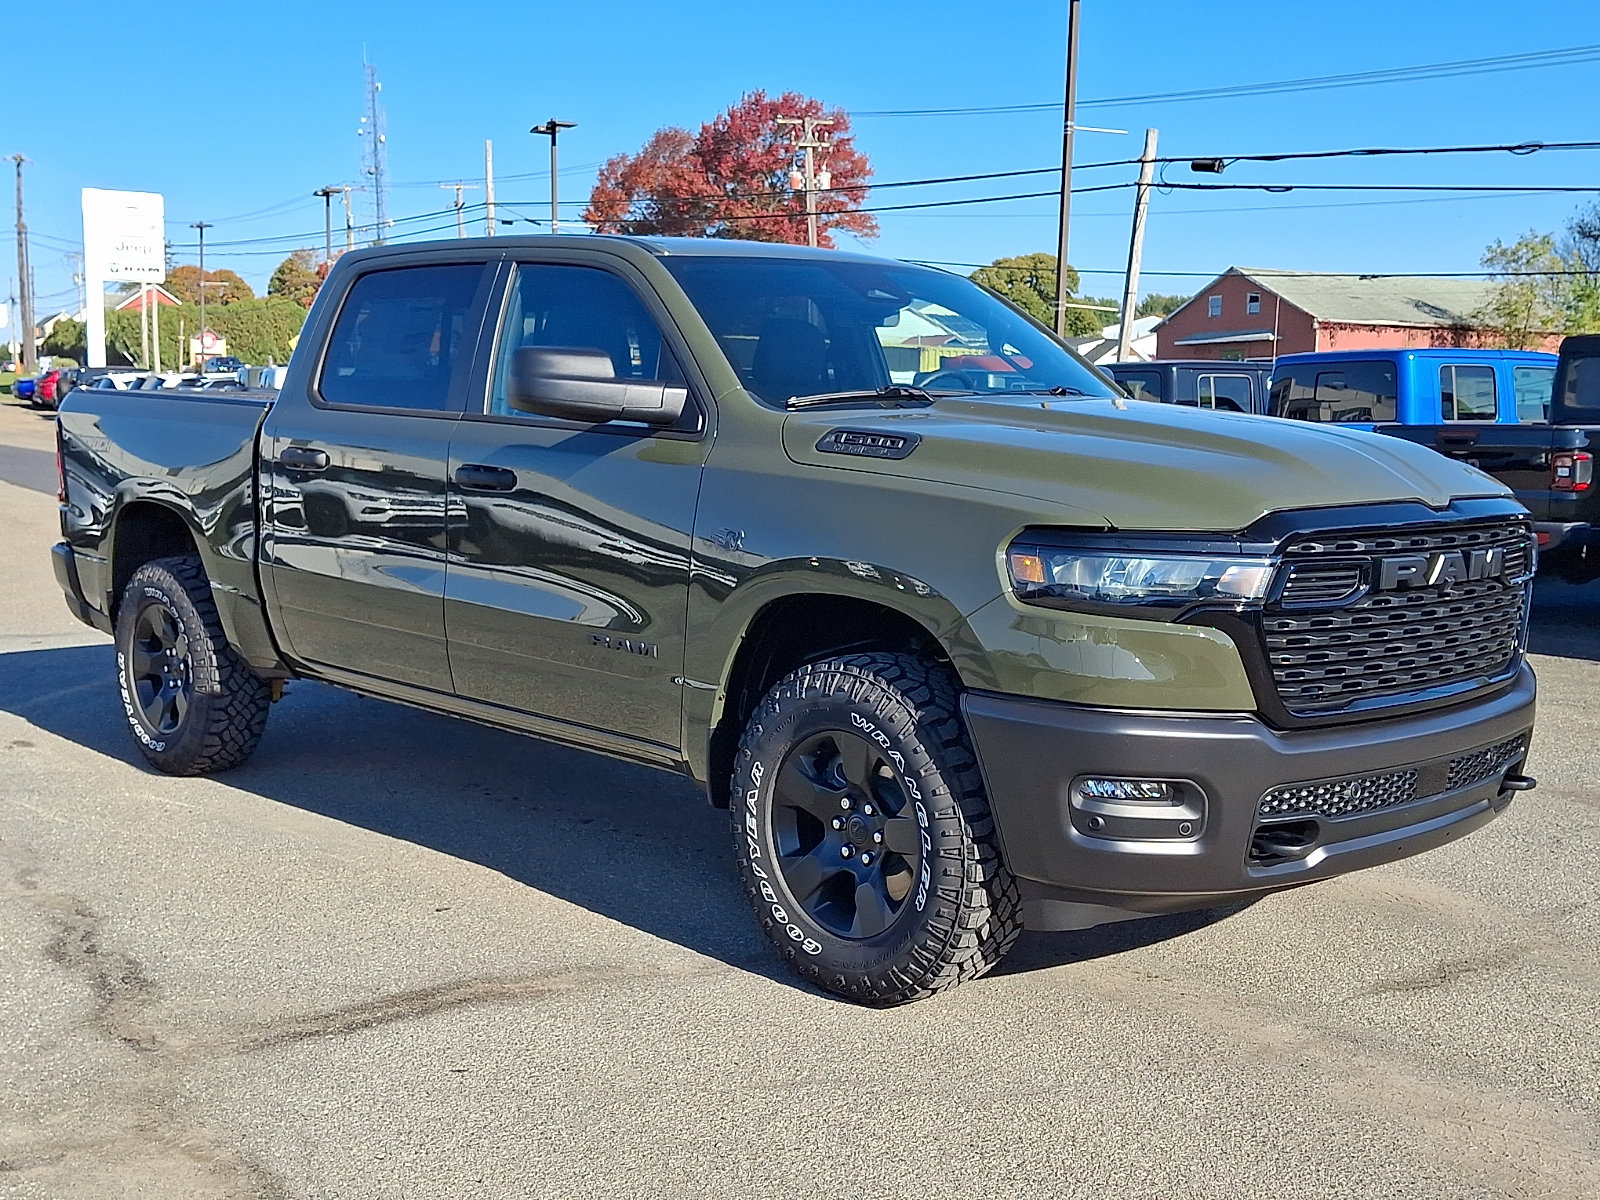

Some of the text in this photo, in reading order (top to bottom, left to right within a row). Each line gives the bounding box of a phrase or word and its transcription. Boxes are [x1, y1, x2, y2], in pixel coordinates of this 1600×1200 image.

[1380, 548, 1504, 590] RAM
[587, 633, 659, 658] RAM
[745, 761, 822, 955] GOODYEAR
[850, 712, 932, 911] WRANGLER
